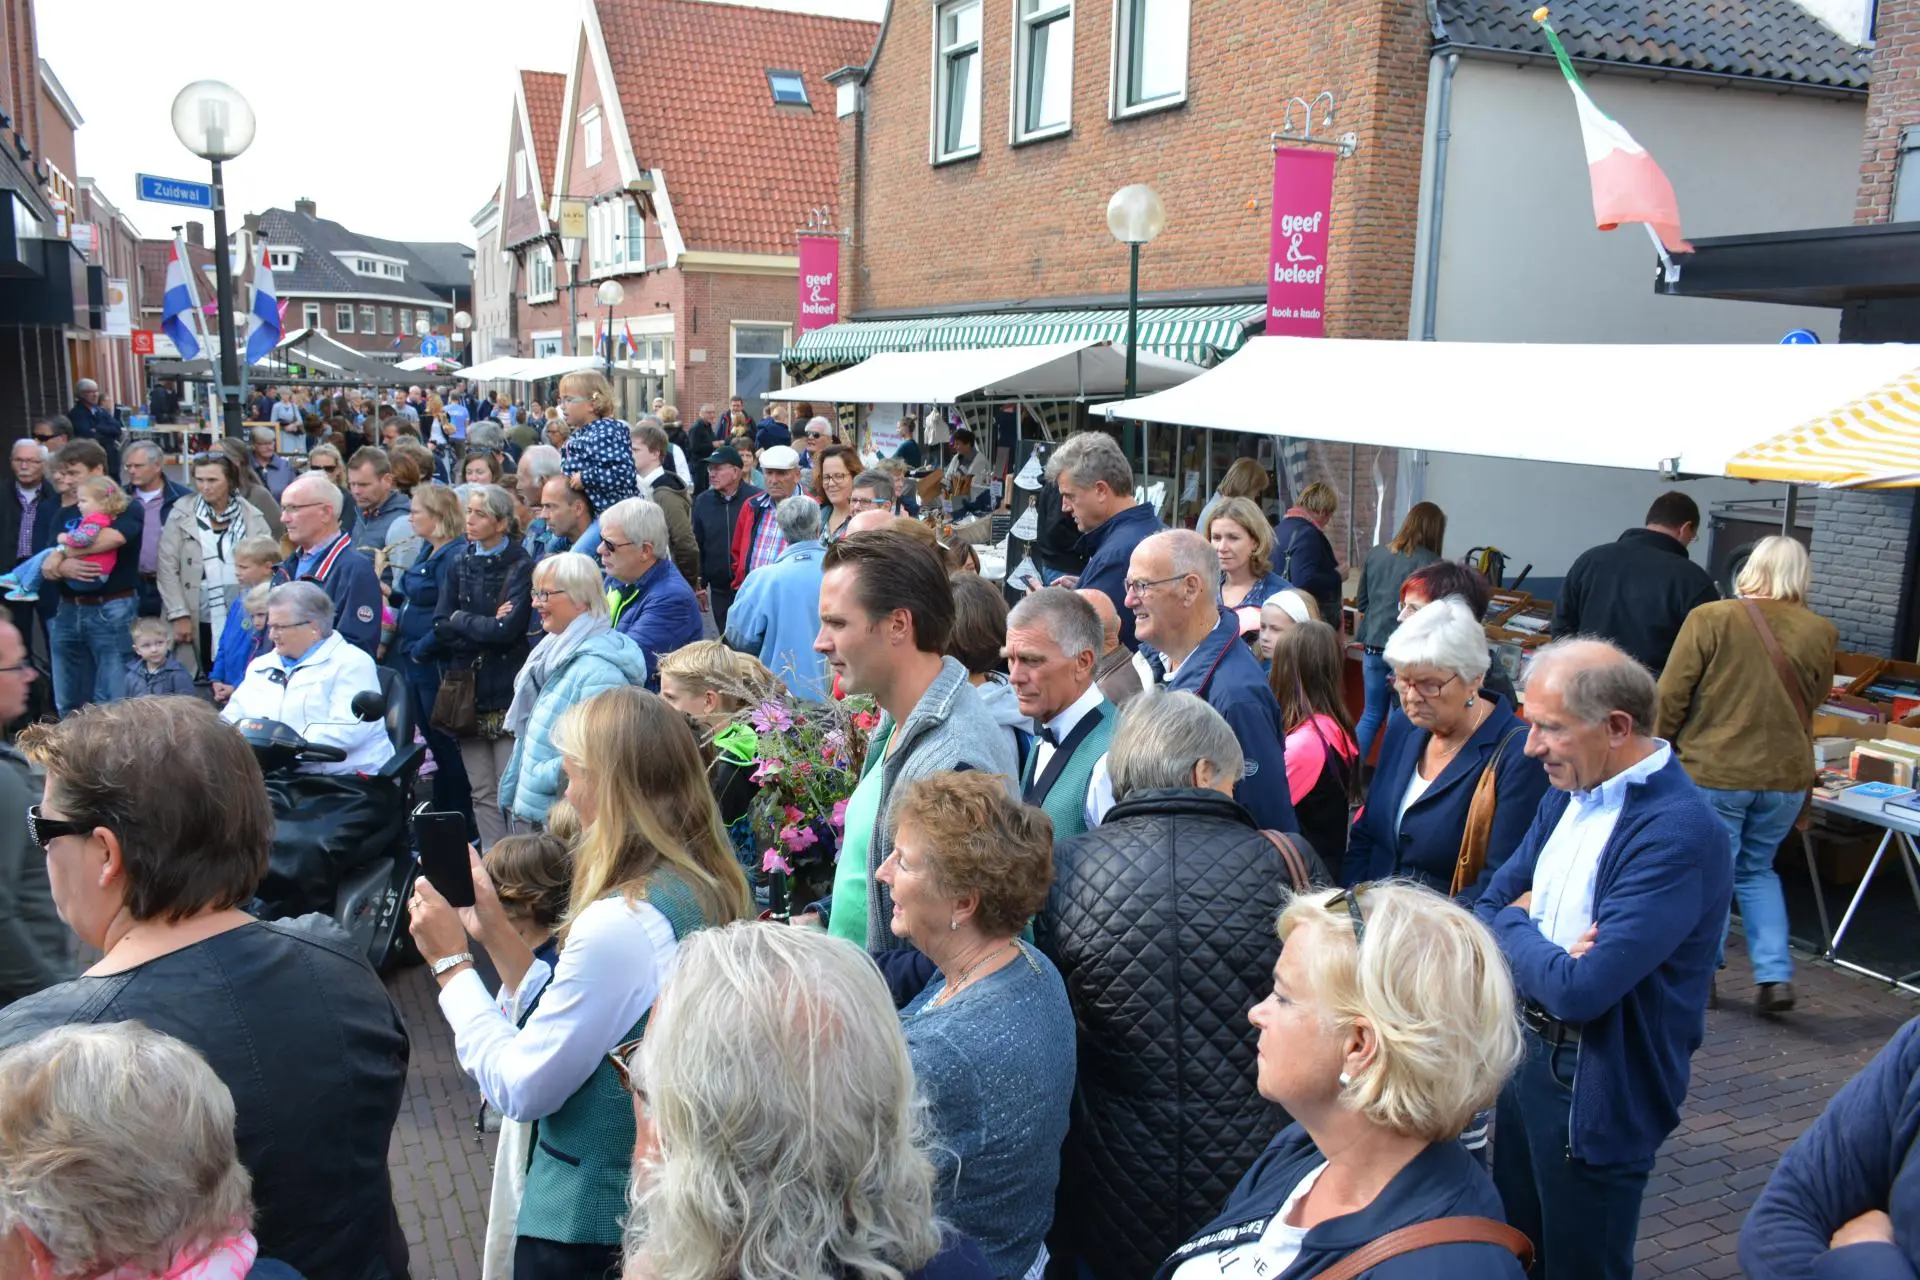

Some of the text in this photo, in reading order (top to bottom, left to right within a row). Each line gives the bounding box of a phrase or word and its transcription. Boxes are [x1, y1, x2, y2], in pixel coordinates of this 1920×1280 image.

[153, 182, 200, 201] Zuidwal
[1281, 211, 1322, 237] geef
[1286, 233, 1316, 262] &
[806, 272, 832, 288] geef
[1274, 262, 1323, 284] beleef
[810, 285, 830, 302] &
[802, 301, 835, 315] beleef
